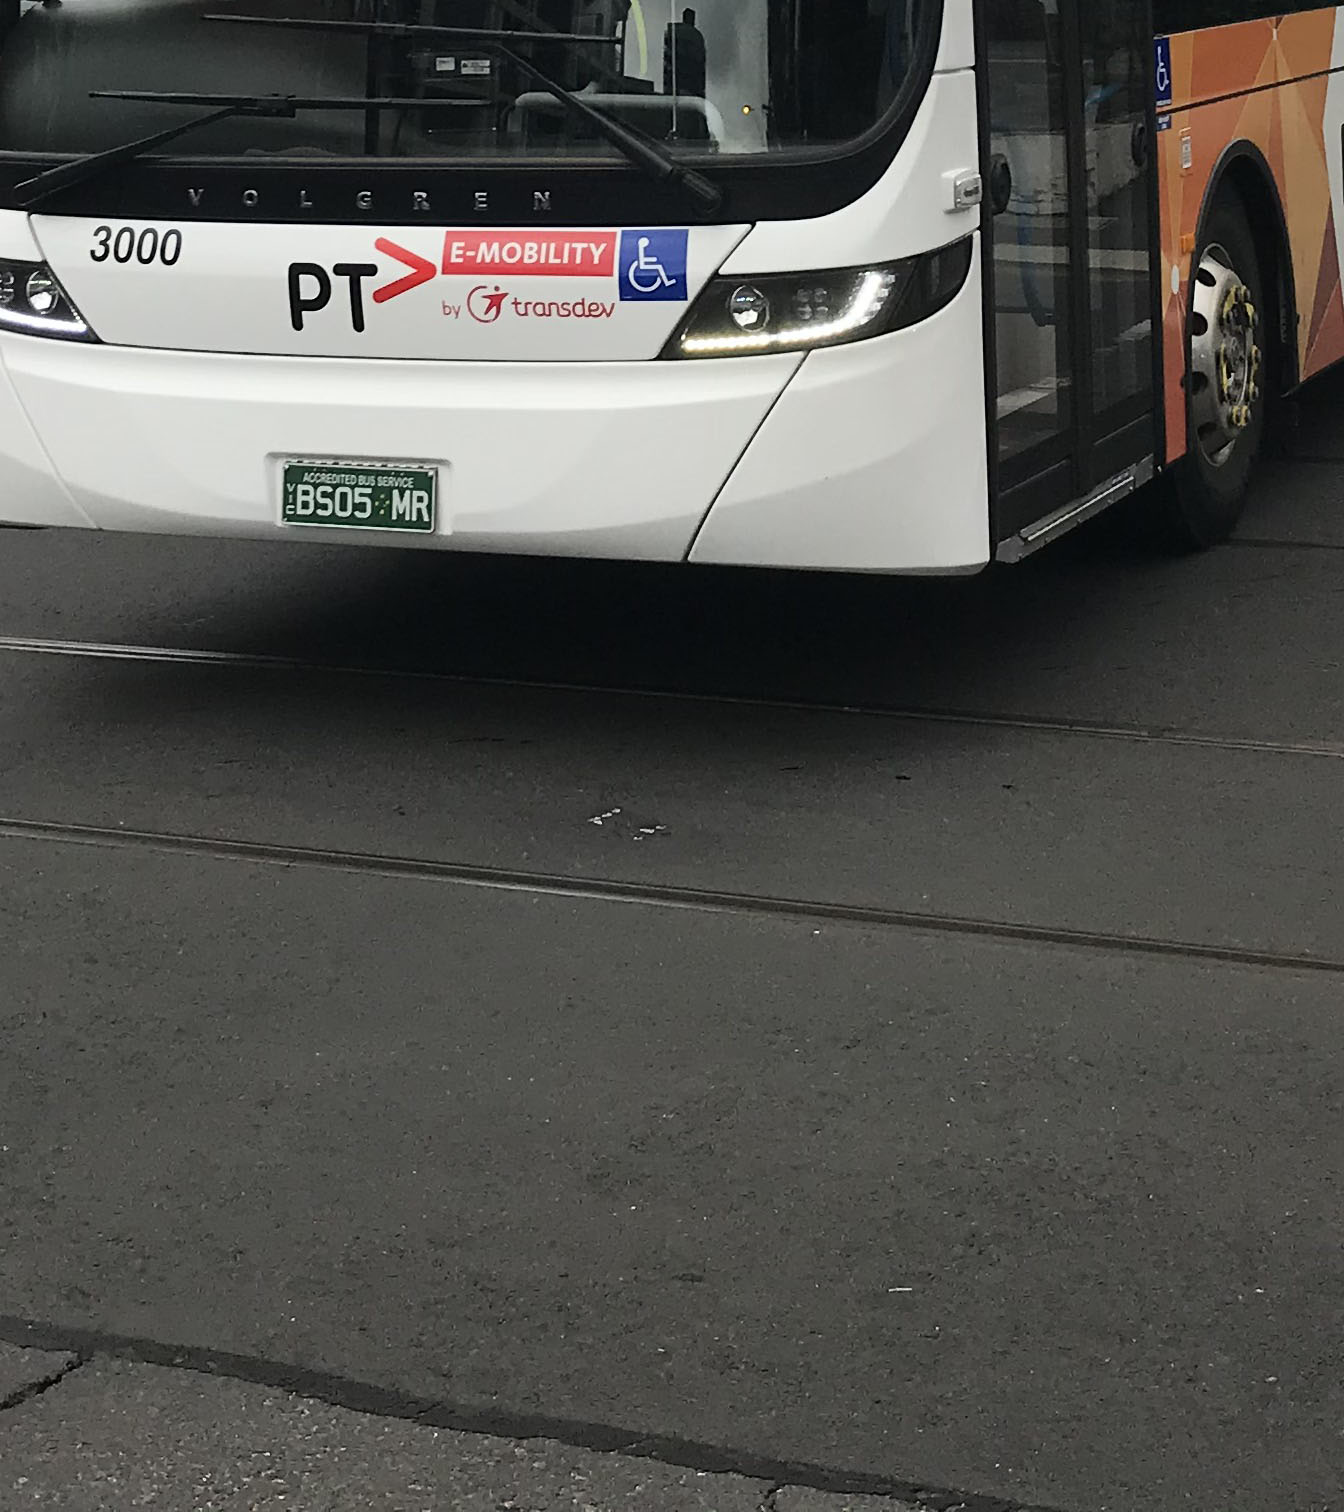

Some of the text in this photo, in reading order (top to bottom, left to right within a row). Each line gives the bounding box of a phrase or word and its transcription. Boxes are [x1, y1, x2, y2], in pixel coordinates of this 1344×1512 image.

[187, 188, 552, 210] VOLGREN
[90, 225, 182, 266] 3000
[449, 241, 608, 264] E-MOBILITY
[441, 296, 616, 320] by transdev
[302, 471, 356, 485] ACCREDITED
[376, 476, 414, 489] SERVICE
[285, 482, 297, 515] VIC
[391, 489, 430, 522] MR
